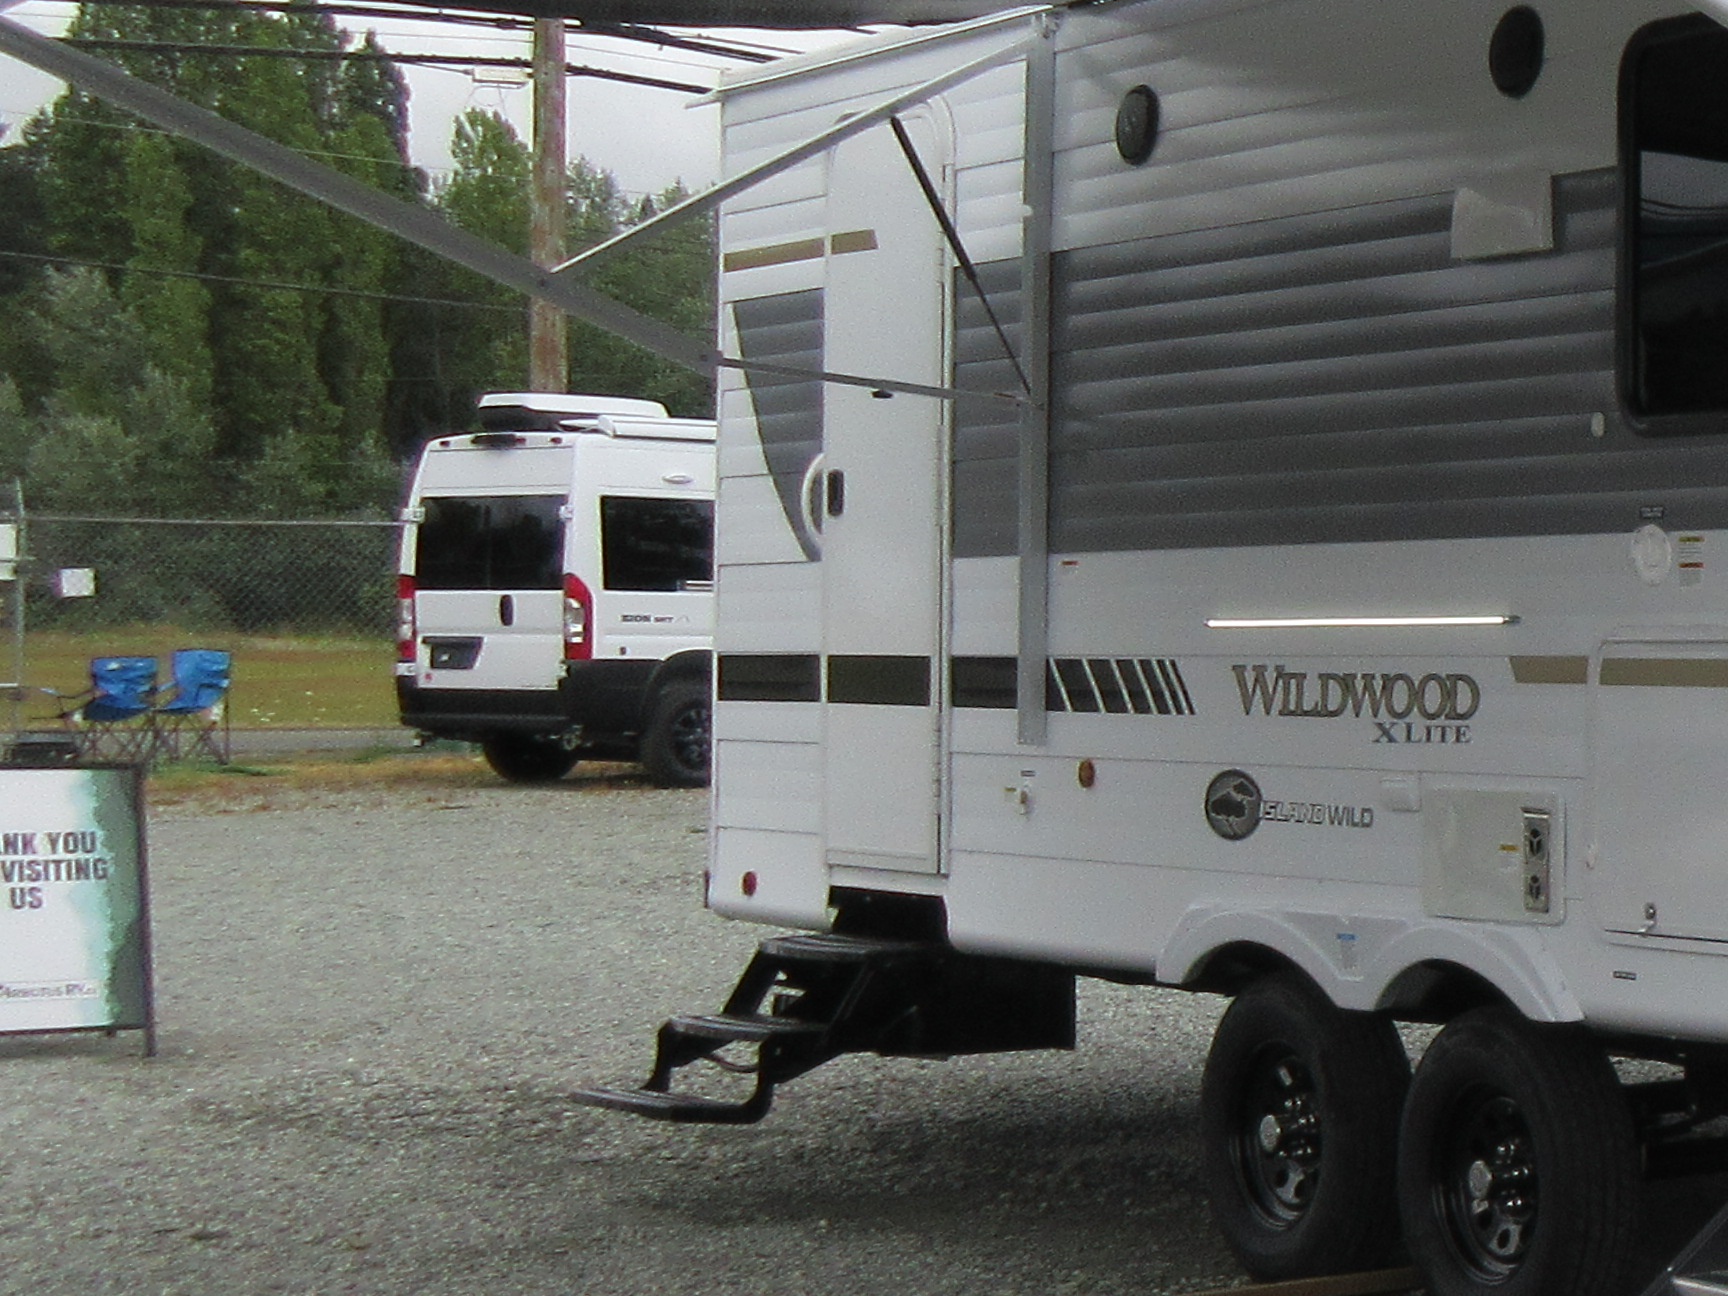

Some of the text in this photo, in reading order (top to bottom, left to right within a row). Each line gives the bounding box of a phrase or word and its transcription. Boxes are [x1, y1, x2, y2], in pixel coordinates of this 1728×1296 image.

[1232, 664, 1481, 721] WILDWOOD
[0, 831, 97, 855] NK YOU
[0, 858, 108, 882] VISITING
[10, 887, 44, 910] US
